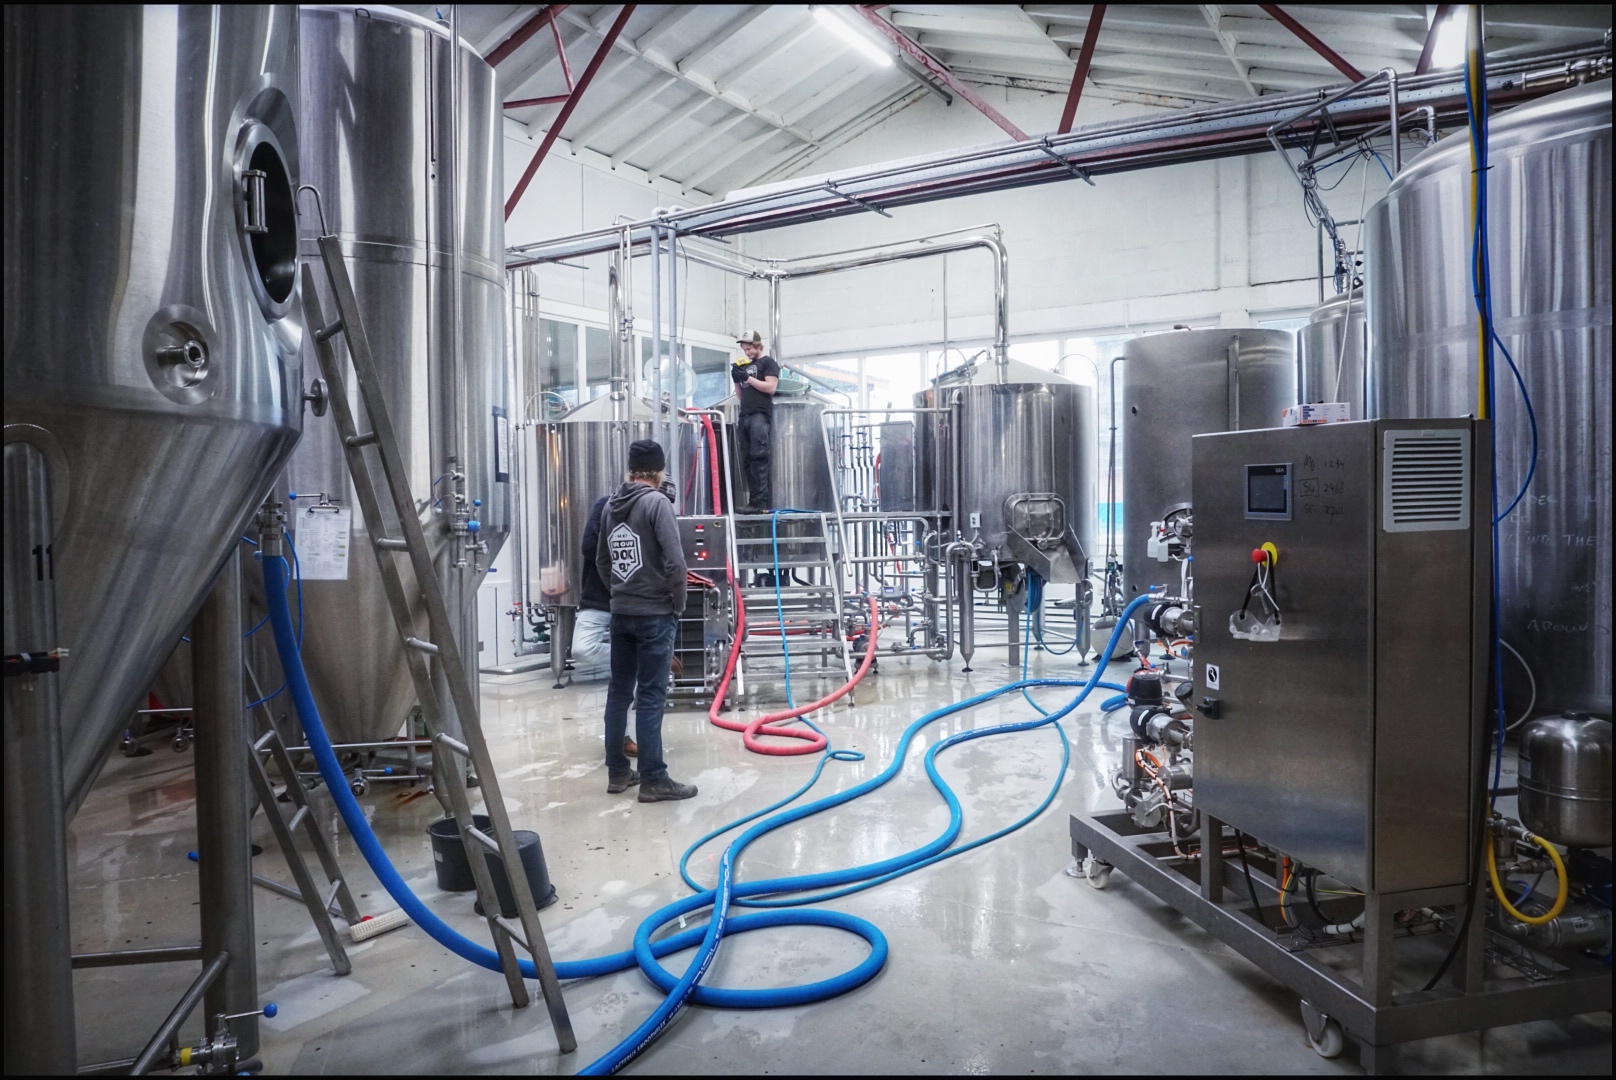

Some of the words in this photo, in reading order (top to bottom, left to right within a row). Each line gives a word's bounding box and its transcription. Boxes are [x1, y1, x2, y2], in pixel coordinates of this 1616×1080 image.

[1324, 458, 1345, 471] 1234
[612, 549, 634, 561] DOK
[32, 544, 54, 581] 11
